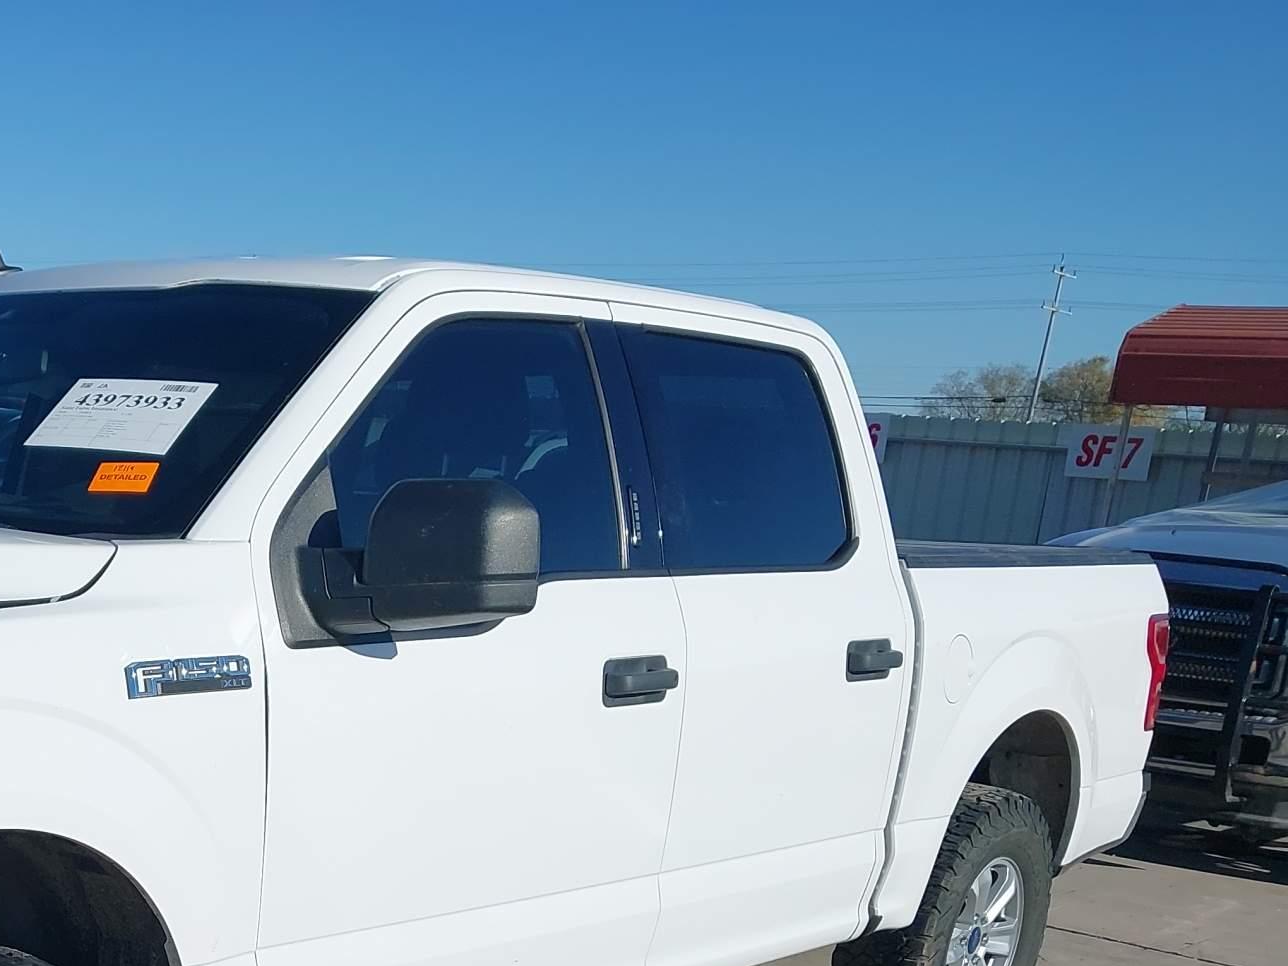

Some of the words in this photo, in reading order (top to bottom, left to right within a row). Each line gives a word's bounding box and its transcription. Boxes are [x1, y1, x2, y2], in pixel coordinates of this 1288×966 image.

[74, 393, 186, 410] 43973933
[1076, 434, 1117, 467] SF
[1121, 437, 1144, 469] 7
[222, 677, 248, 688] XLT
